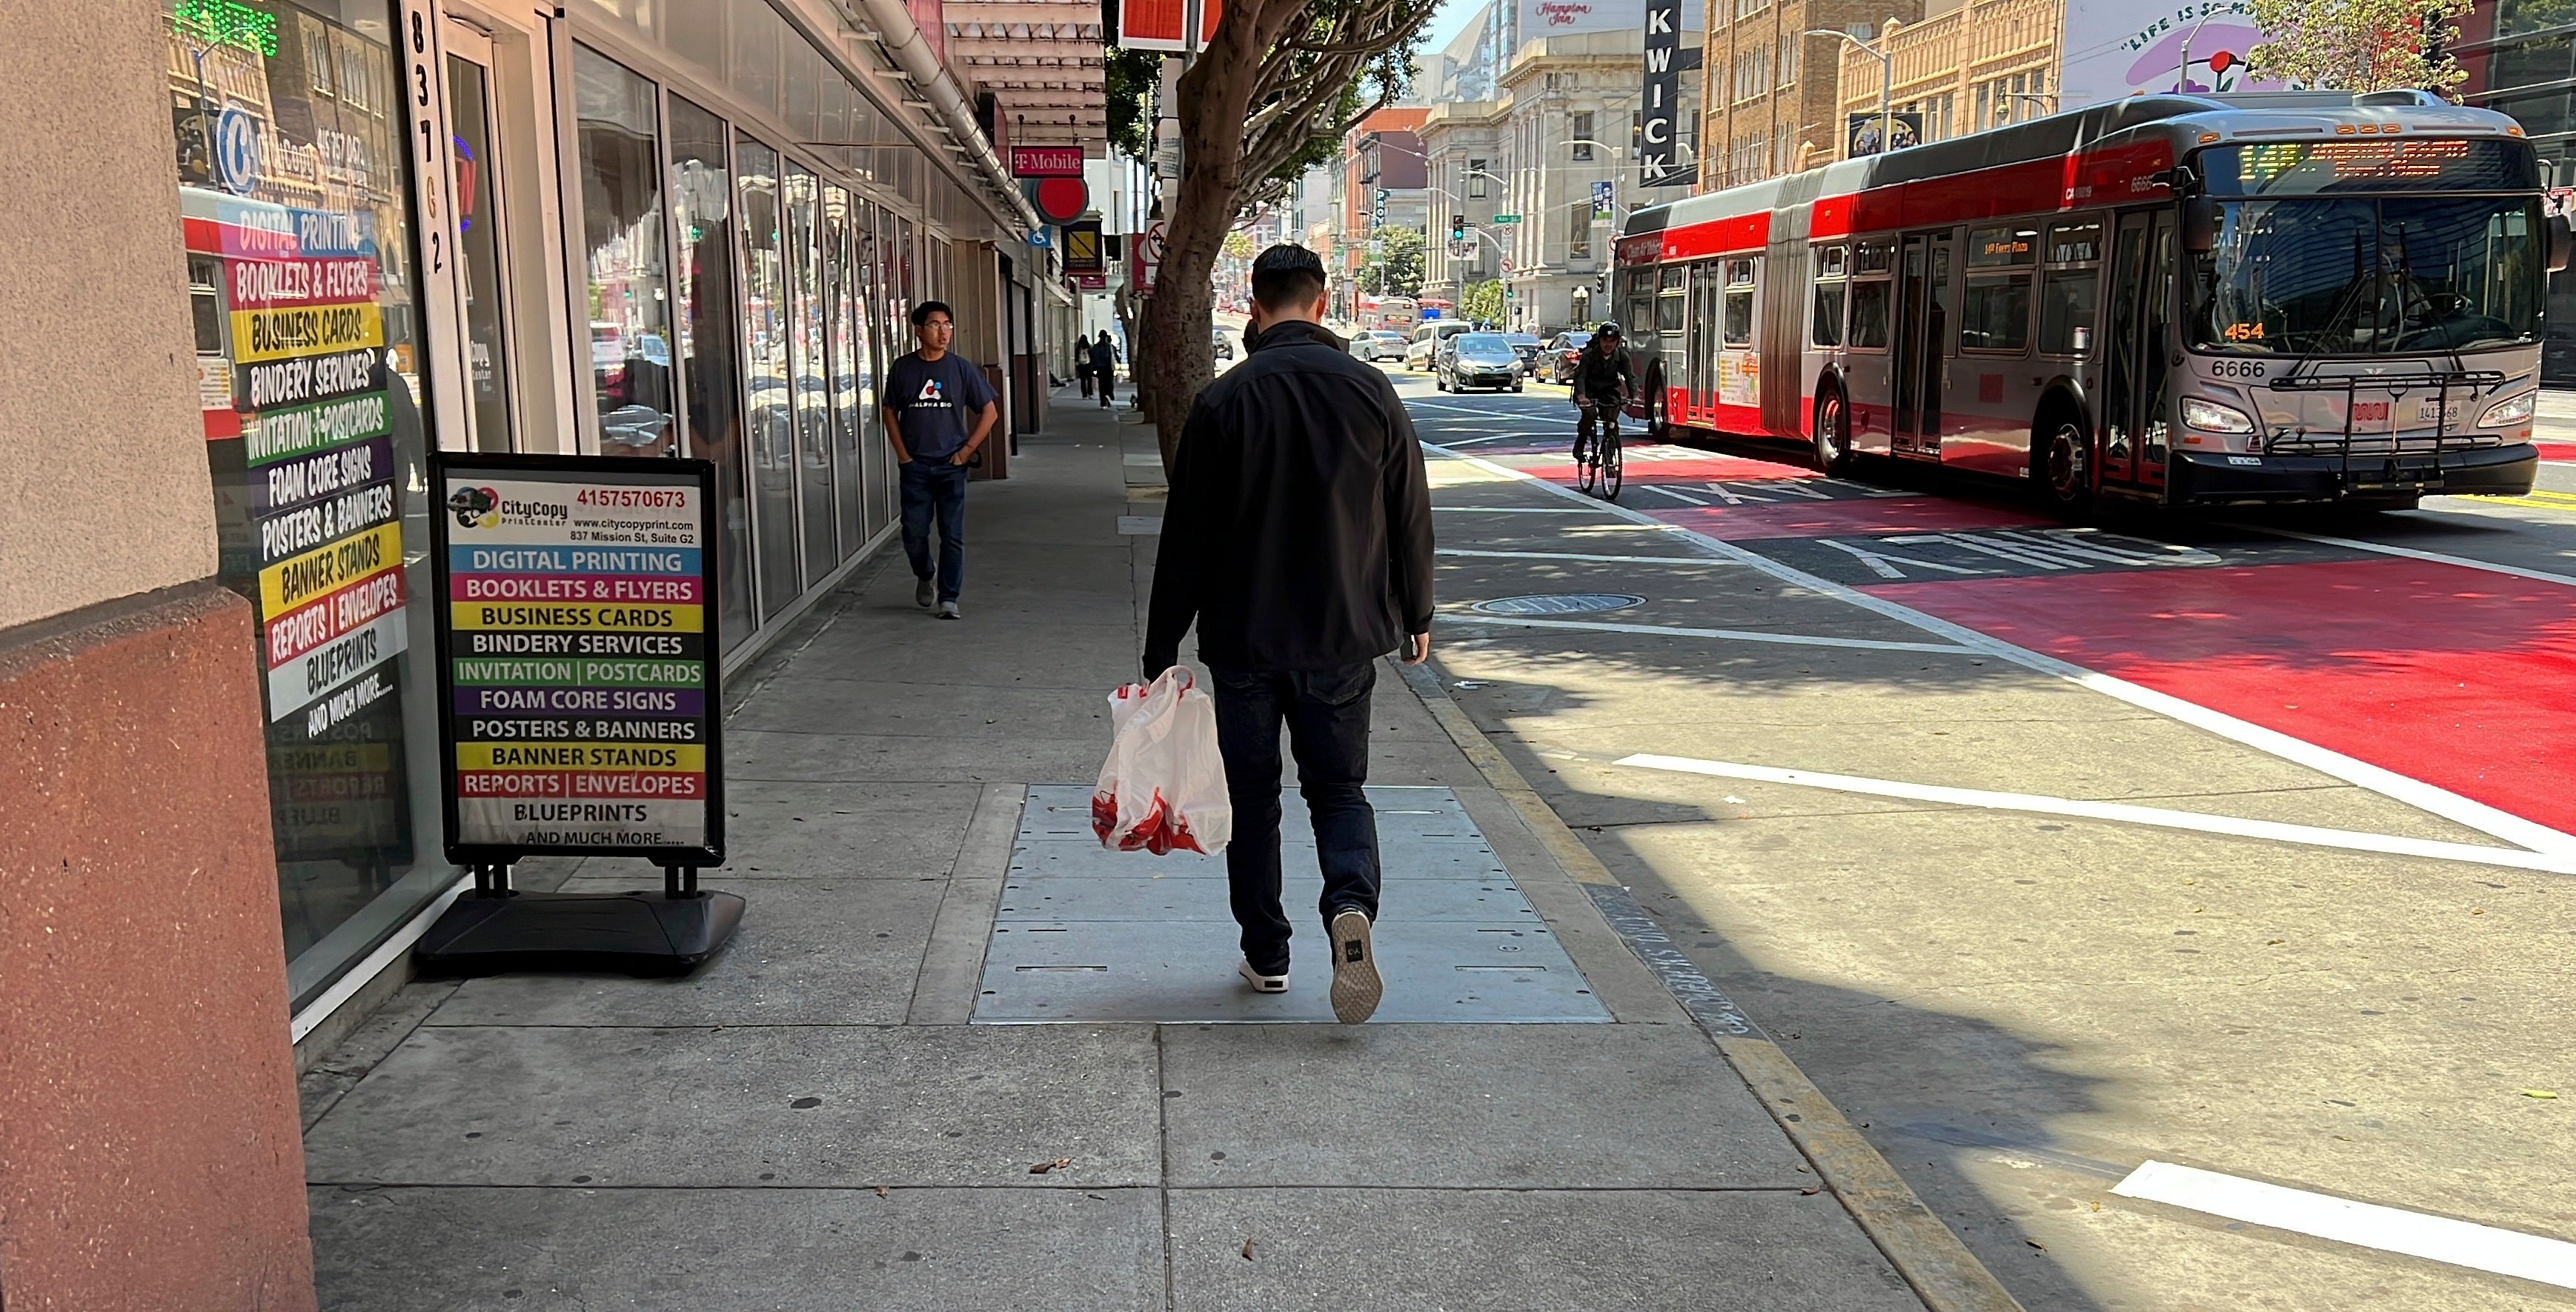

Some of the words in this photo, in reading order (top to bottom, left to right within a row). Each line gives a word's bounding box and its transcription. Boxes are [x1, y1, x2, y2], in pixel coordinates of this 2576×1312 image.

[1536, 2, 1592, 16] Hampton
[2177, 6, 2194, 22] IS
[1549, 13, 1576, 27] Inn
[412, 10, 432, 162] 837
[1644, 8, 1673, 179] KWICK
[1031, 153, 1081, 170] Mobile
[239, 210, 297, 250] DIGITAL
[300, 213, 360, 250] PRINTING
[236, 262, 310, 302] BOOKLETS
[313, 261, 323, 299] &
[326, 260, 368, 297] FLYERS
[252, 310, 319, 353] BUSINESS
[322, 307, 362, 344] CARDS
[2225, 322, 2263, 340] 454
[250, 360, 312, 407] BINDERY
[314, 352, 371, 396] SERVICES
[2212, 361, 2265, 377] 6666
[247, 410, 312, 460] INVITATION
[324, 396, 383, 443] POSTCARDS
[268, 462, 305, 507] FOAM
[308, 453, 339, 496] CORE
[340, 444, 371, 487] SIGNS
[577, 490, 686, 508] 4157570673
[502, 501, 568, 519] CityCopy
[262, 505, 322, 562] POSTERS
[324, 501, 334, 539] &
[337, 484, 392, 534] BANNERS
[574, 519, 694, 532] www.citycopyprint.com
[570, 531, 587, 540] 837
[591, 531, 631, 542] Mission
[634, 533, 648, 544] St,
[651, 533, 677, 543] Suite
[680, 534, 694, 544] G2
[282, 550, 333, 605] BANNER
[337, 533, 380, 582] STANDS
[473, 550, 565, 570] DIGITAL
[572, 553, 682, 572] PRINTING
[467, 579, 587, 598] BOOKLETS
[592, 581, 609, 599] &
[615, 580, 693, 600] FLYERS
[271, 603, 326, 664] REPORTS
[338, 573, 396, 631] ENVELOPES
[482, 607, 591, 625] BUSINESS
[598, 609, 673, 627] CARDS
[473, 634, 573, 653] BINDERY
[578, 635, 683, 655] SERVICES
[306, 627, 376, 696] BLUEPRINTS
[459, 662, 571, 680] INVITATION
[587, 665, 702, 682] POSTCARDS
[480, 690, 546, 709] FOAM
[551, 691, 608, 709] CORE
[613, 692, 677, 711] SIGNS
[308, 703, 328, 739] AND
[328, 686, 356, 725] MUCH
[473, 720, 569, 738] POSTERS
[574, 721, 591, 739] &
[596, 721, 696, 740] BANNERS
[492, 747, 584, 766] BANNER
[590, 749, 677, 767] STANDS
[465, 774, 560, 793] REPORTS
[576, 775, 696, 796] ENVELOPES
[514, 805, 648, 822] BLUEPRINTS
[526, 833, 561, 845] AND
[564, 832, 612, 845] MUCH
